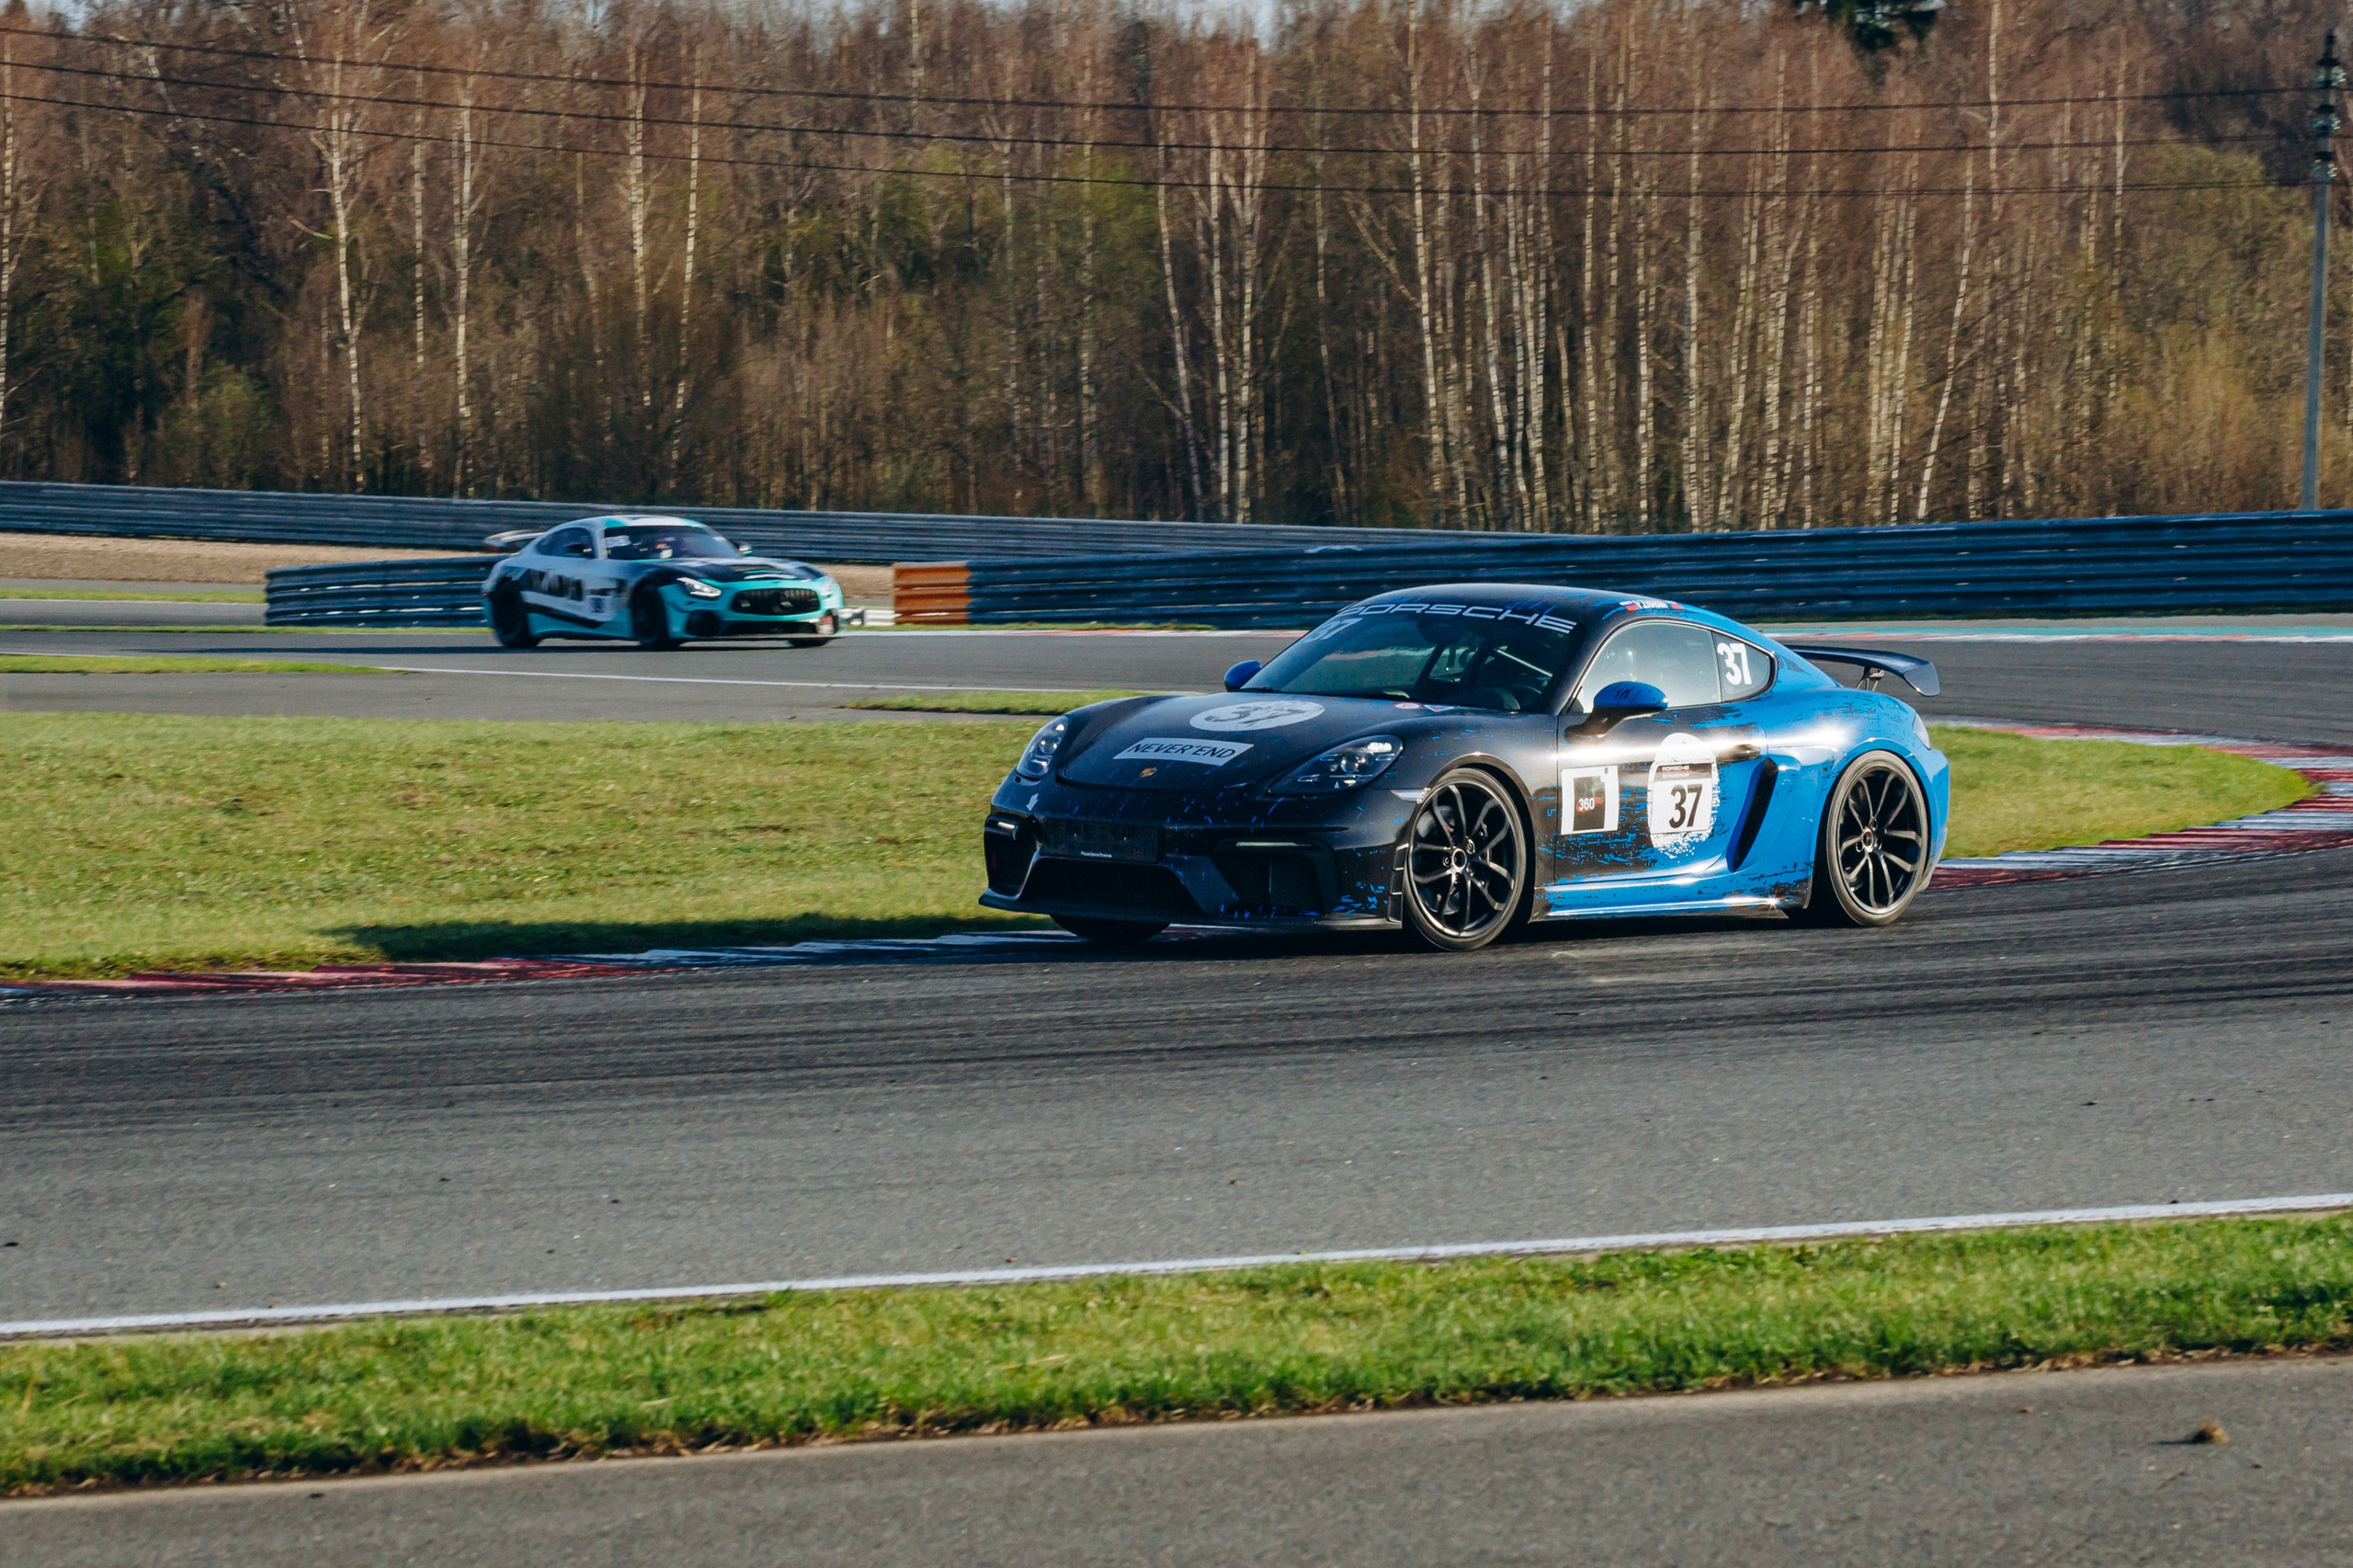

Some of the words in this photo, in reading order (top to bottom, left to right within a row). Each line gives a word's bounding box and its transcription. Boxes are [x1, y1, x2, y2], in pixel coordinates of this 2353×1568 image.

[1303, 617, 1363, 643] 37
[1336, 603, 1577, 634] PORSCHE
[1717, 642, 1752, 686] 37
[1203, 705, 1306, 725] 37
[1668, 783, 1703, 829] 37
